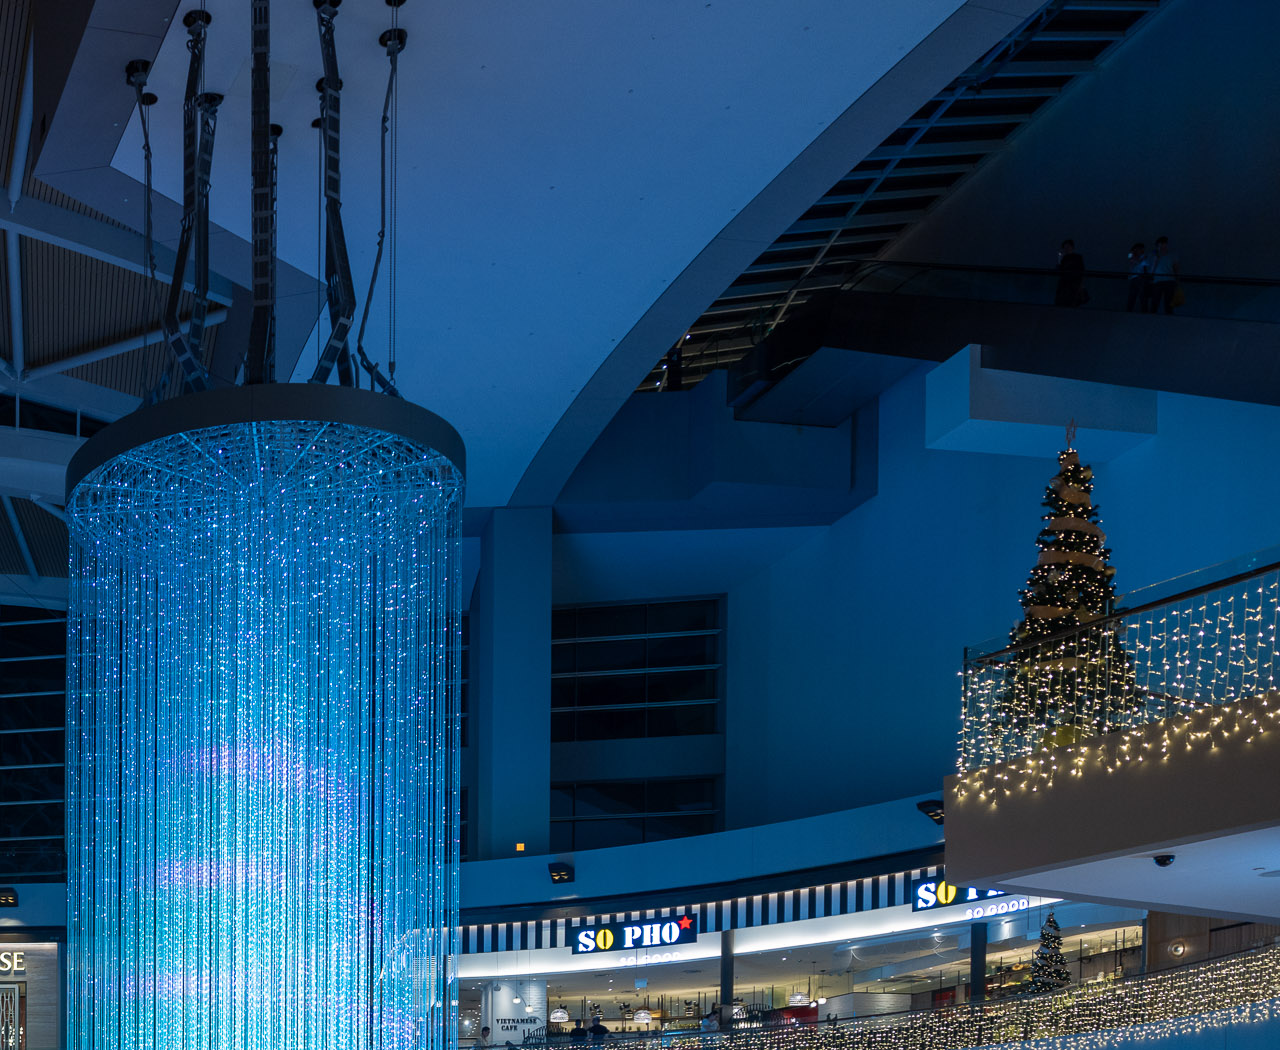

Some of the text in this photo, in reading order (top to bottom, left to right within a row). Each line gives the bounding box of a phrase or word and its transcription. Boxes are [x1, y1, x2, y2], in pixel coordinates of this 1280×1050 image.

[965, 898, 1029, 920] SO GOOD
[578, 921, 681, 953] SO PHO
[495, 1017, 538, 1026] VIETNAMESE
